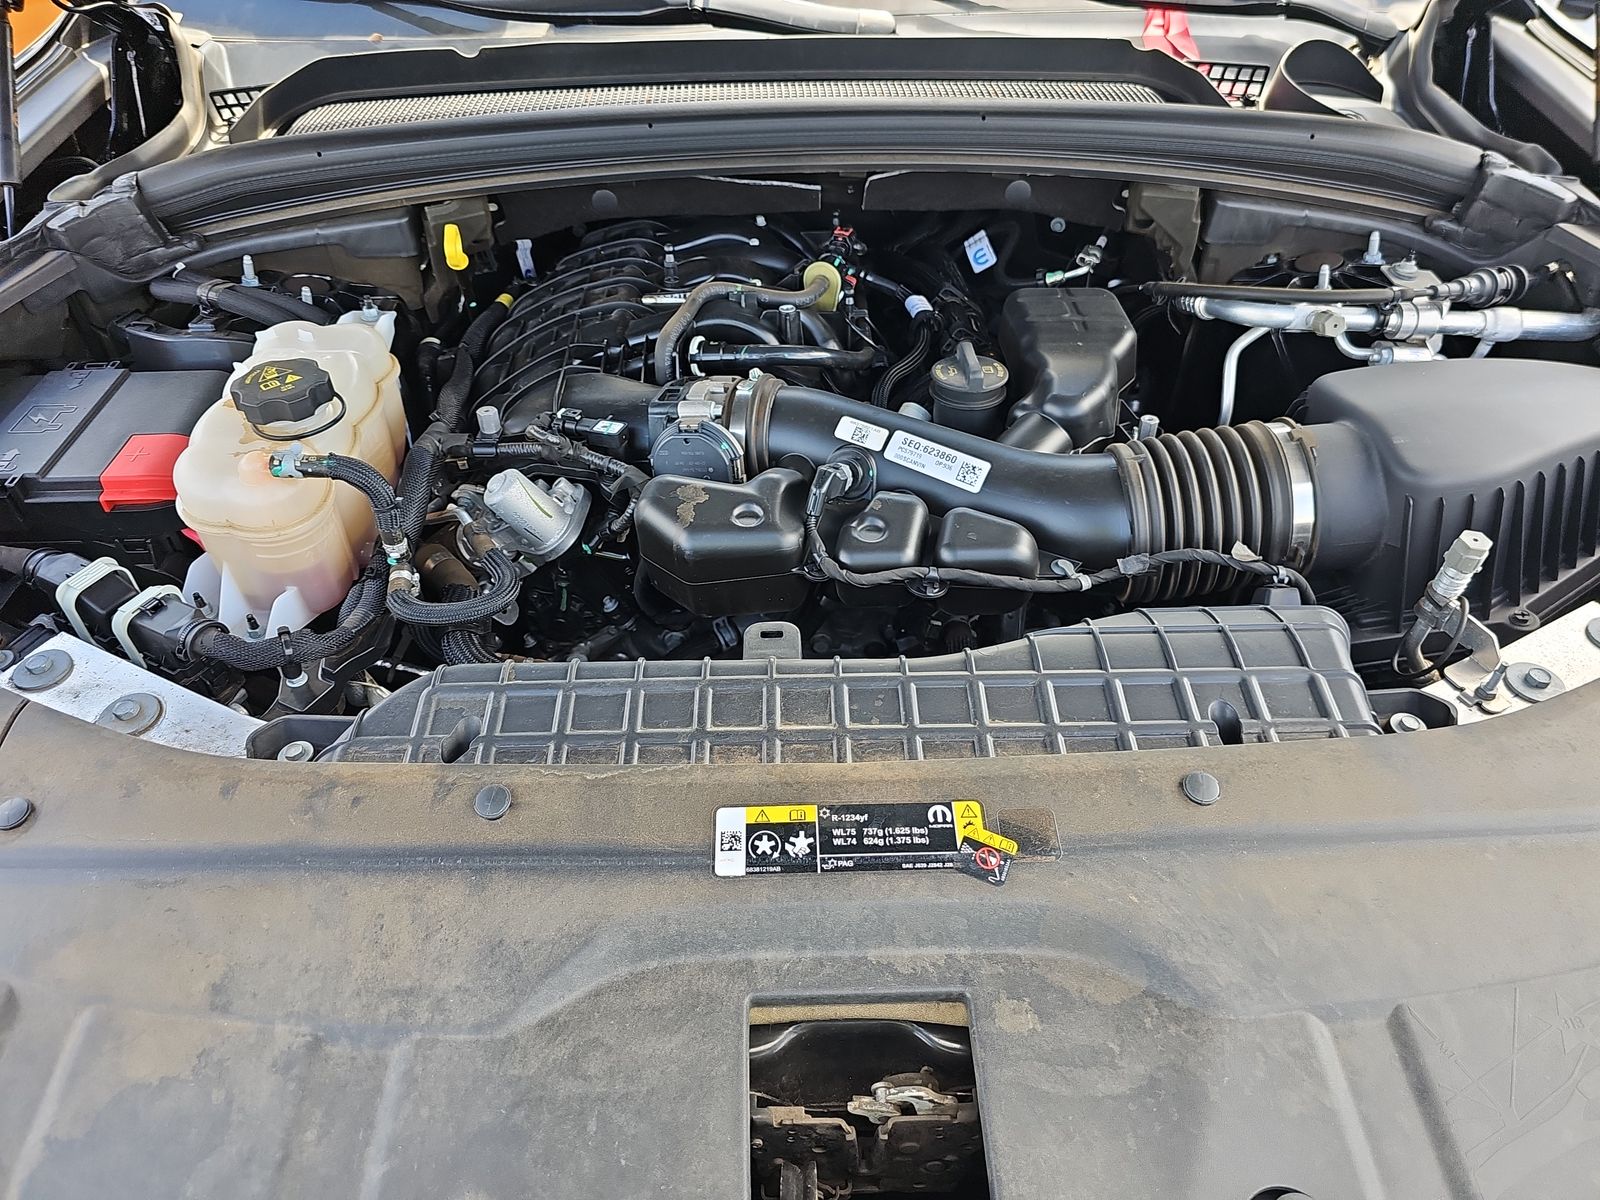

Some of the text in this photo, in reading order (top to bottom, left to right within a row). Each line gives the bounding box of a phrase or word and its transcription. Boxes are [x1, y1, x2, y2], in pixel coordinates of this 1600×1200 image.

[901, 437, 958, 464] SEQ:623860
[831, 814, 869, 823] R-1234yf
[832, 827, 929, 837] WL75 737g (1.625 lbs)
[832, 836, 930, 846] WL74 624g (1.375 lbs)
[837, 860, 854, 868] PAG
